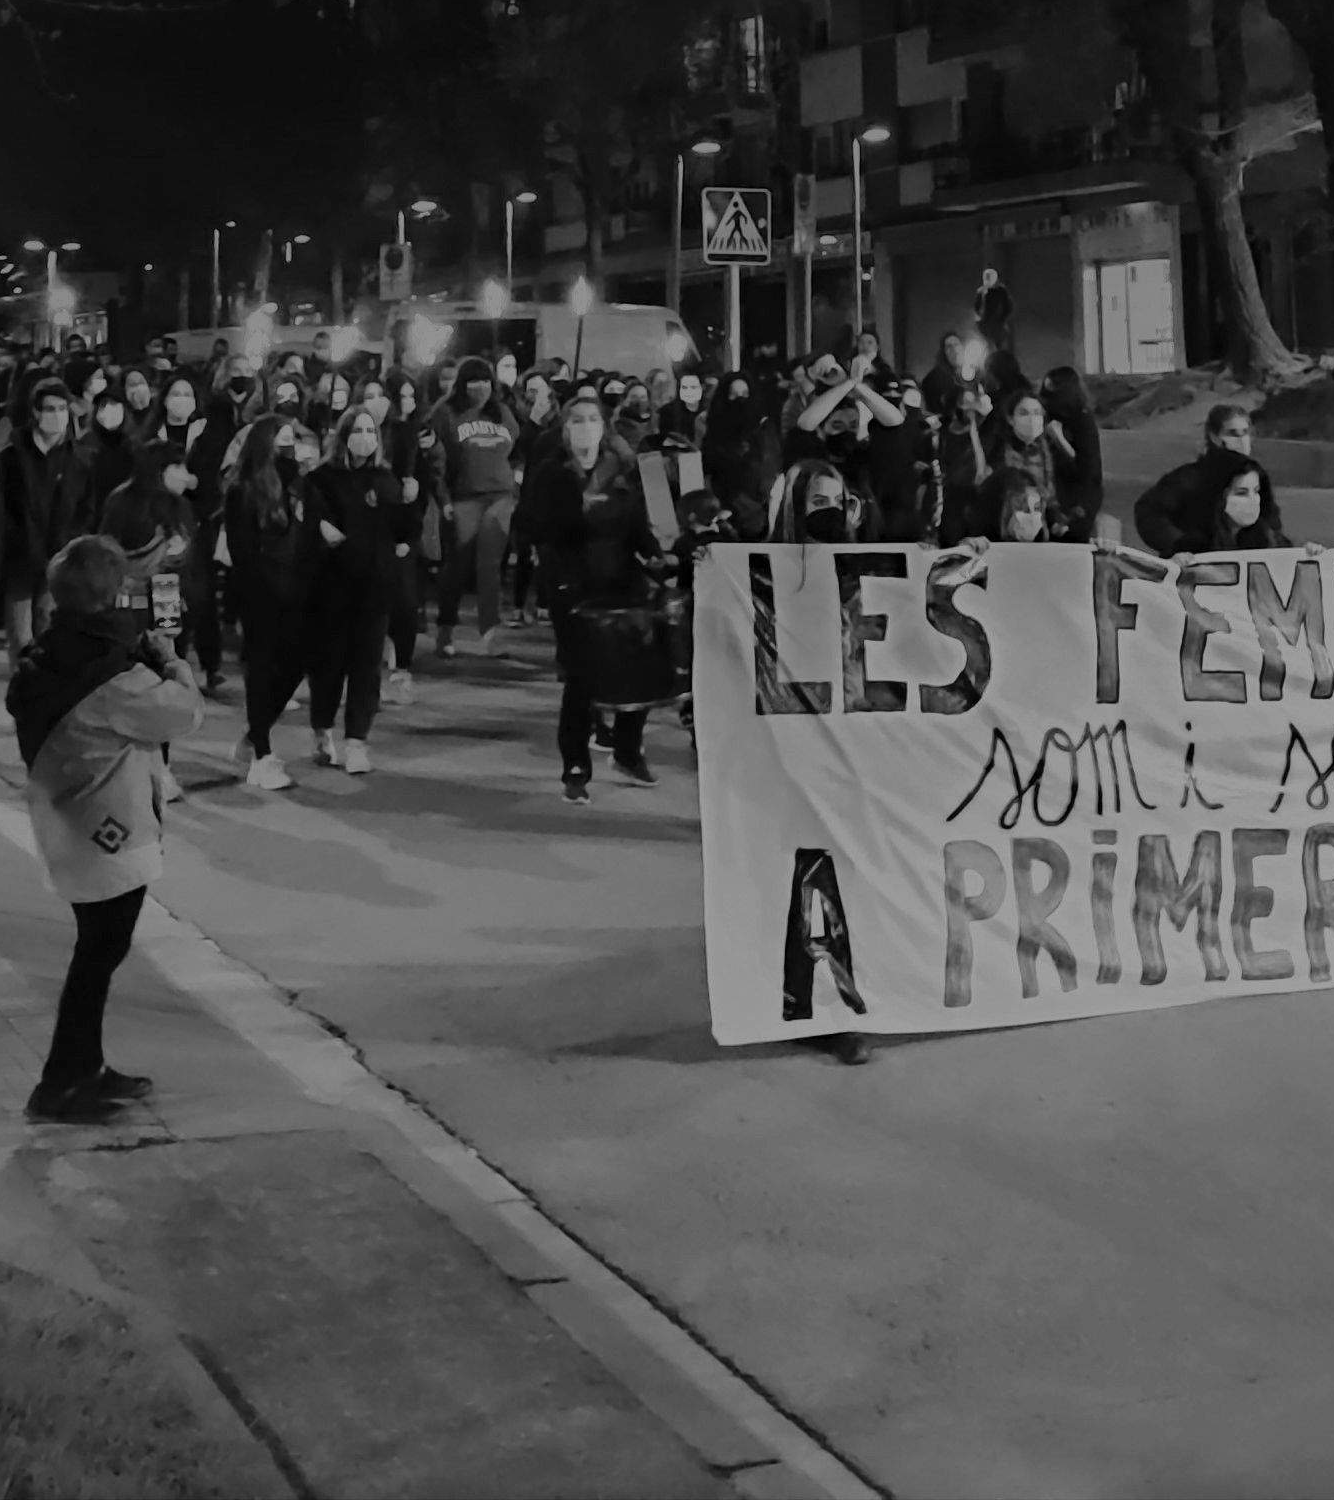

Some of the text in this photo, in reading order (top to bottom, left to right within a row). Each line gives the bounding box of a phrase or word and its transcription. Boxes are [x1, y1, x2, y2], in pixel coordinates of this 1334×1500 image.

[748, 551, 992, 716] LES
[945, 719, 1158, 831] som
[1180, 721, 1225, 811] i
[782, 848, 868, 1021] A
